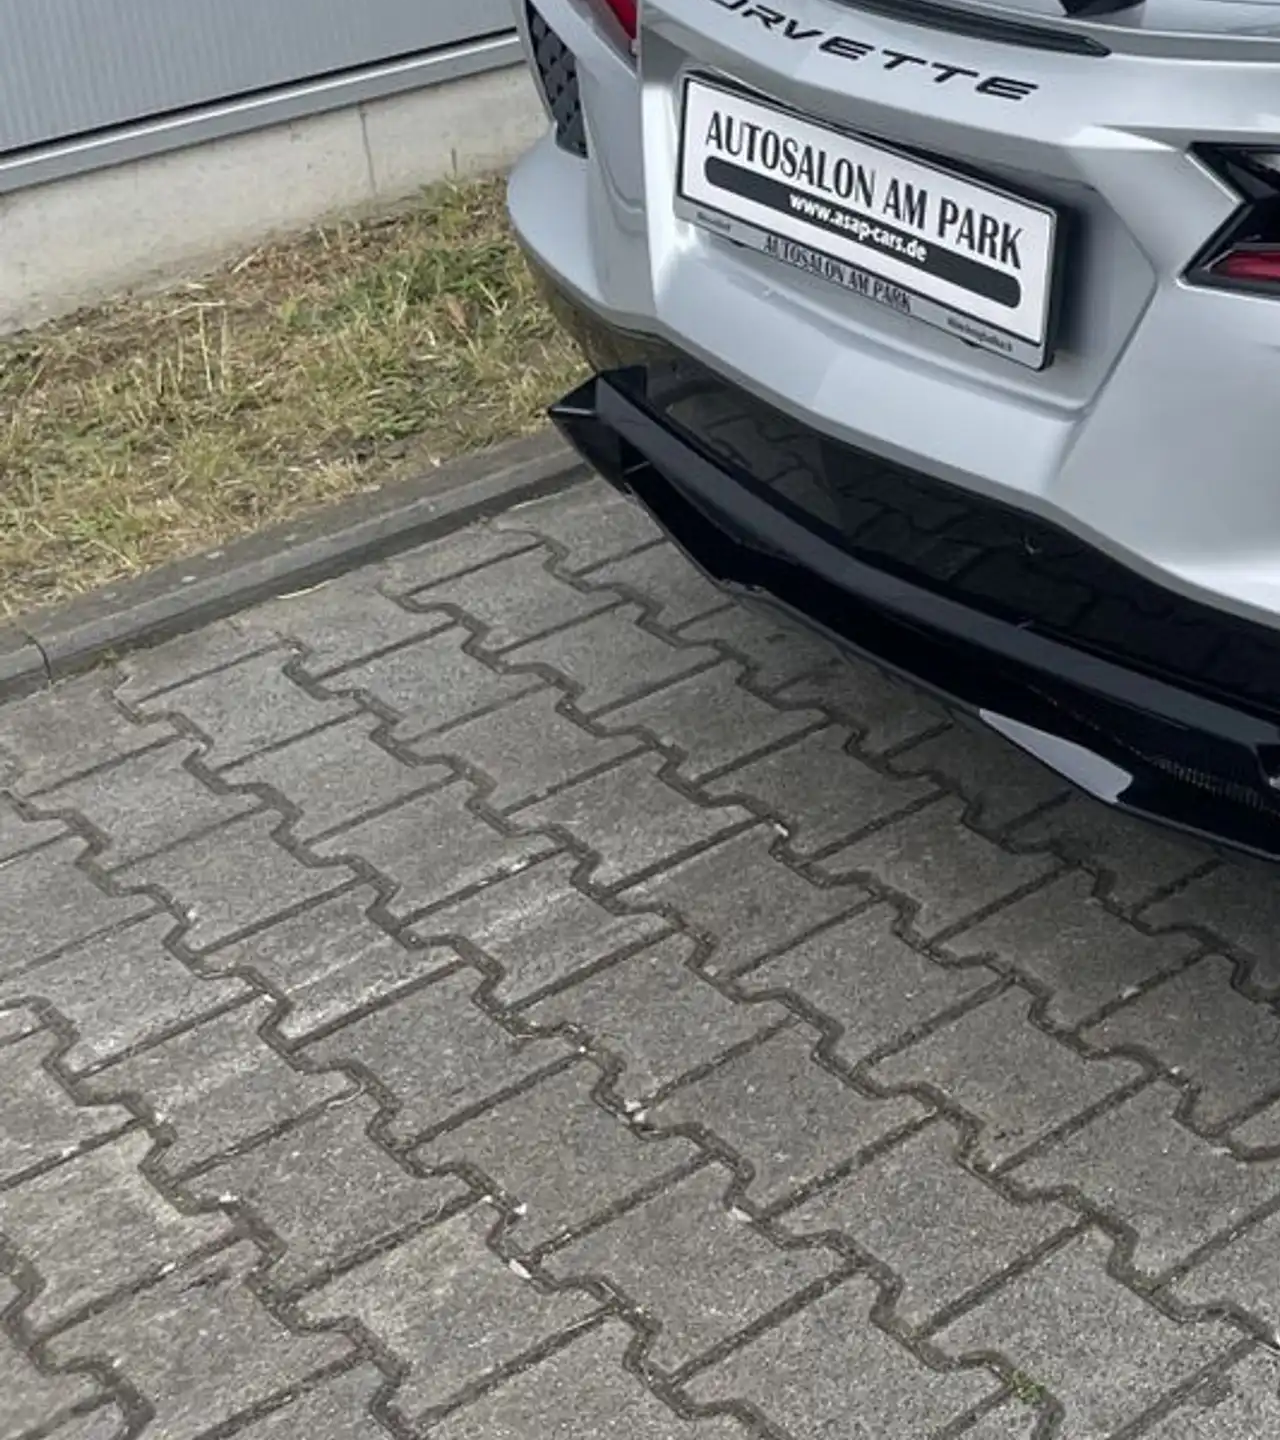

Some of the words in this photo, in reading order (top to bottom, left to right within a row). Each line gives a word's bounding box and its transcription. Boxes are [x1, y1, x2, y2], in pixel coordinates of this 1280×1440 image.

[705, 111, 876, 209] AUTOSALON
[882, 178, 928, 231] AM
[937, 197, 1025, 269] PARK
[788, 192, 929, 263] www.asap-cars.de
